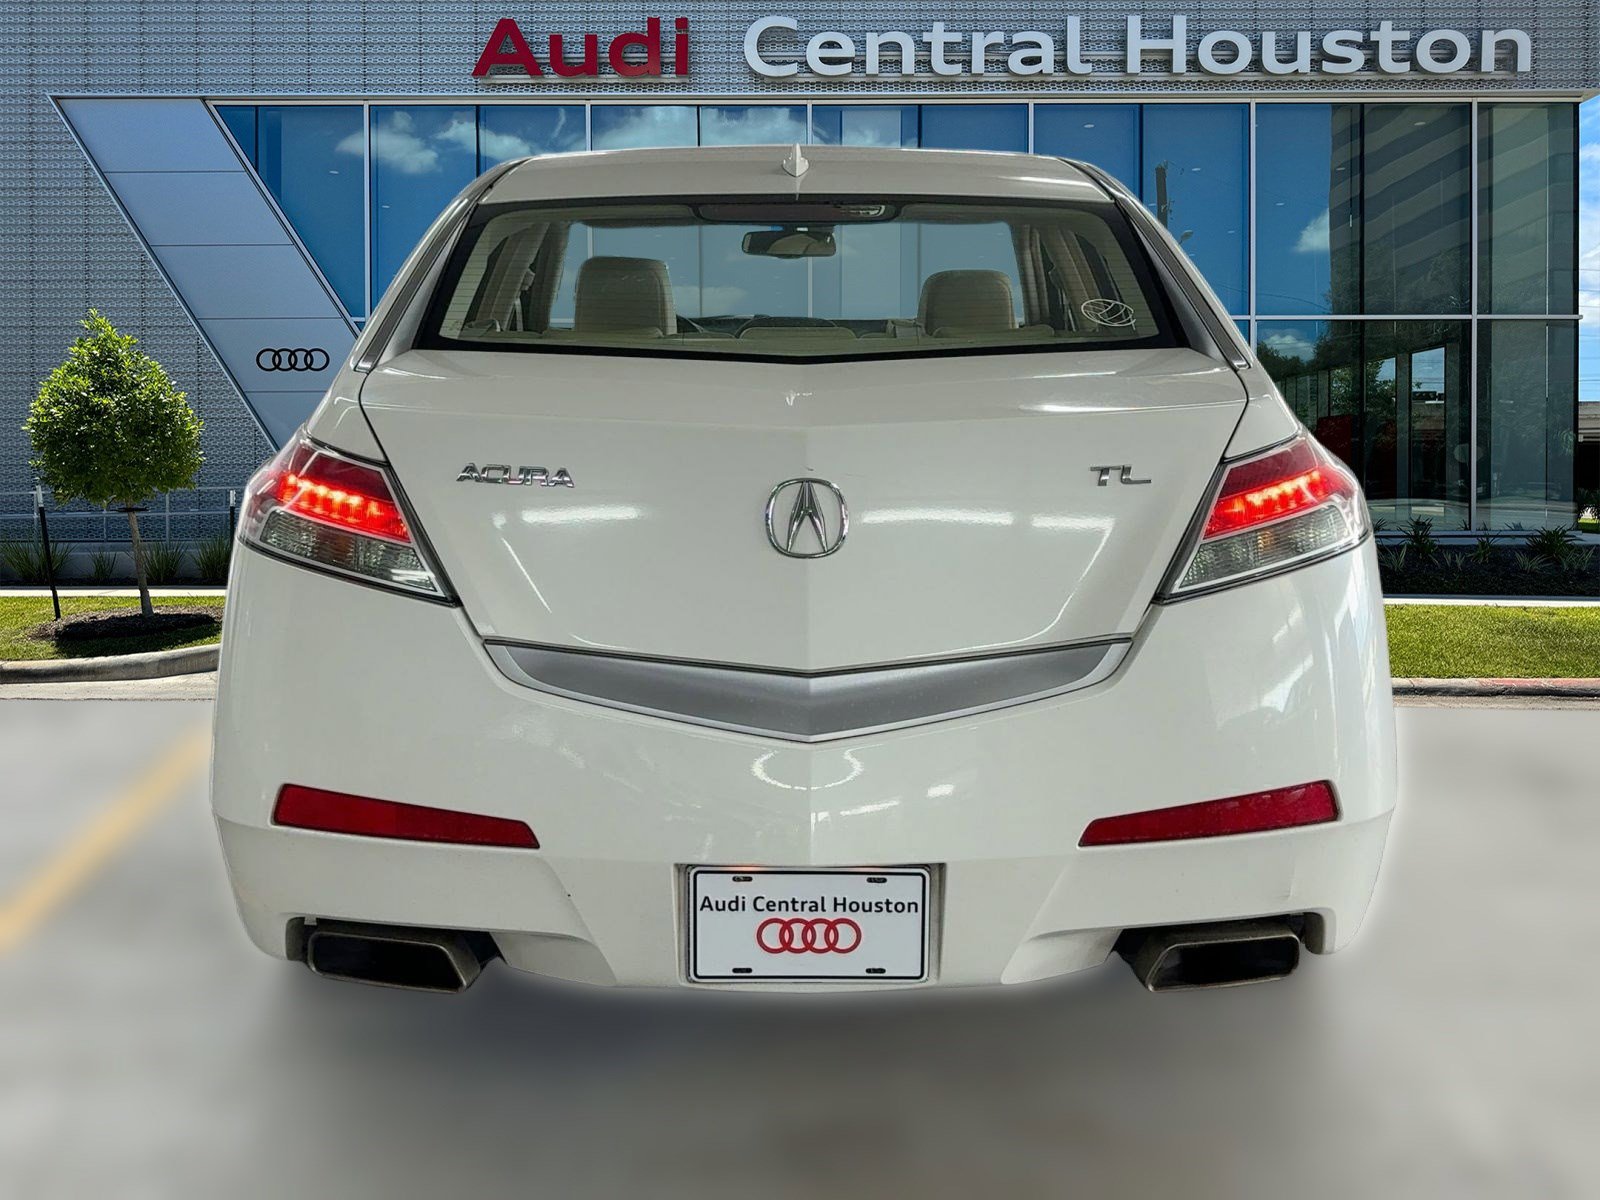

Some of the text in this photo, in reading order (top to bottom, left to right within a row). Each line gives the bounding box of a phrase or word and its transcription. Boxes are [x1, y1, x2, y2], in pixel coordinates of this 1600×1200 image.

[471, 15, 1532, 78] Audi Central Houston
[456, 462, 575, 488] ACURA
[1089, 465, 1152, 486] TL
[700, 896, 919, 914] Audi Central Houston
